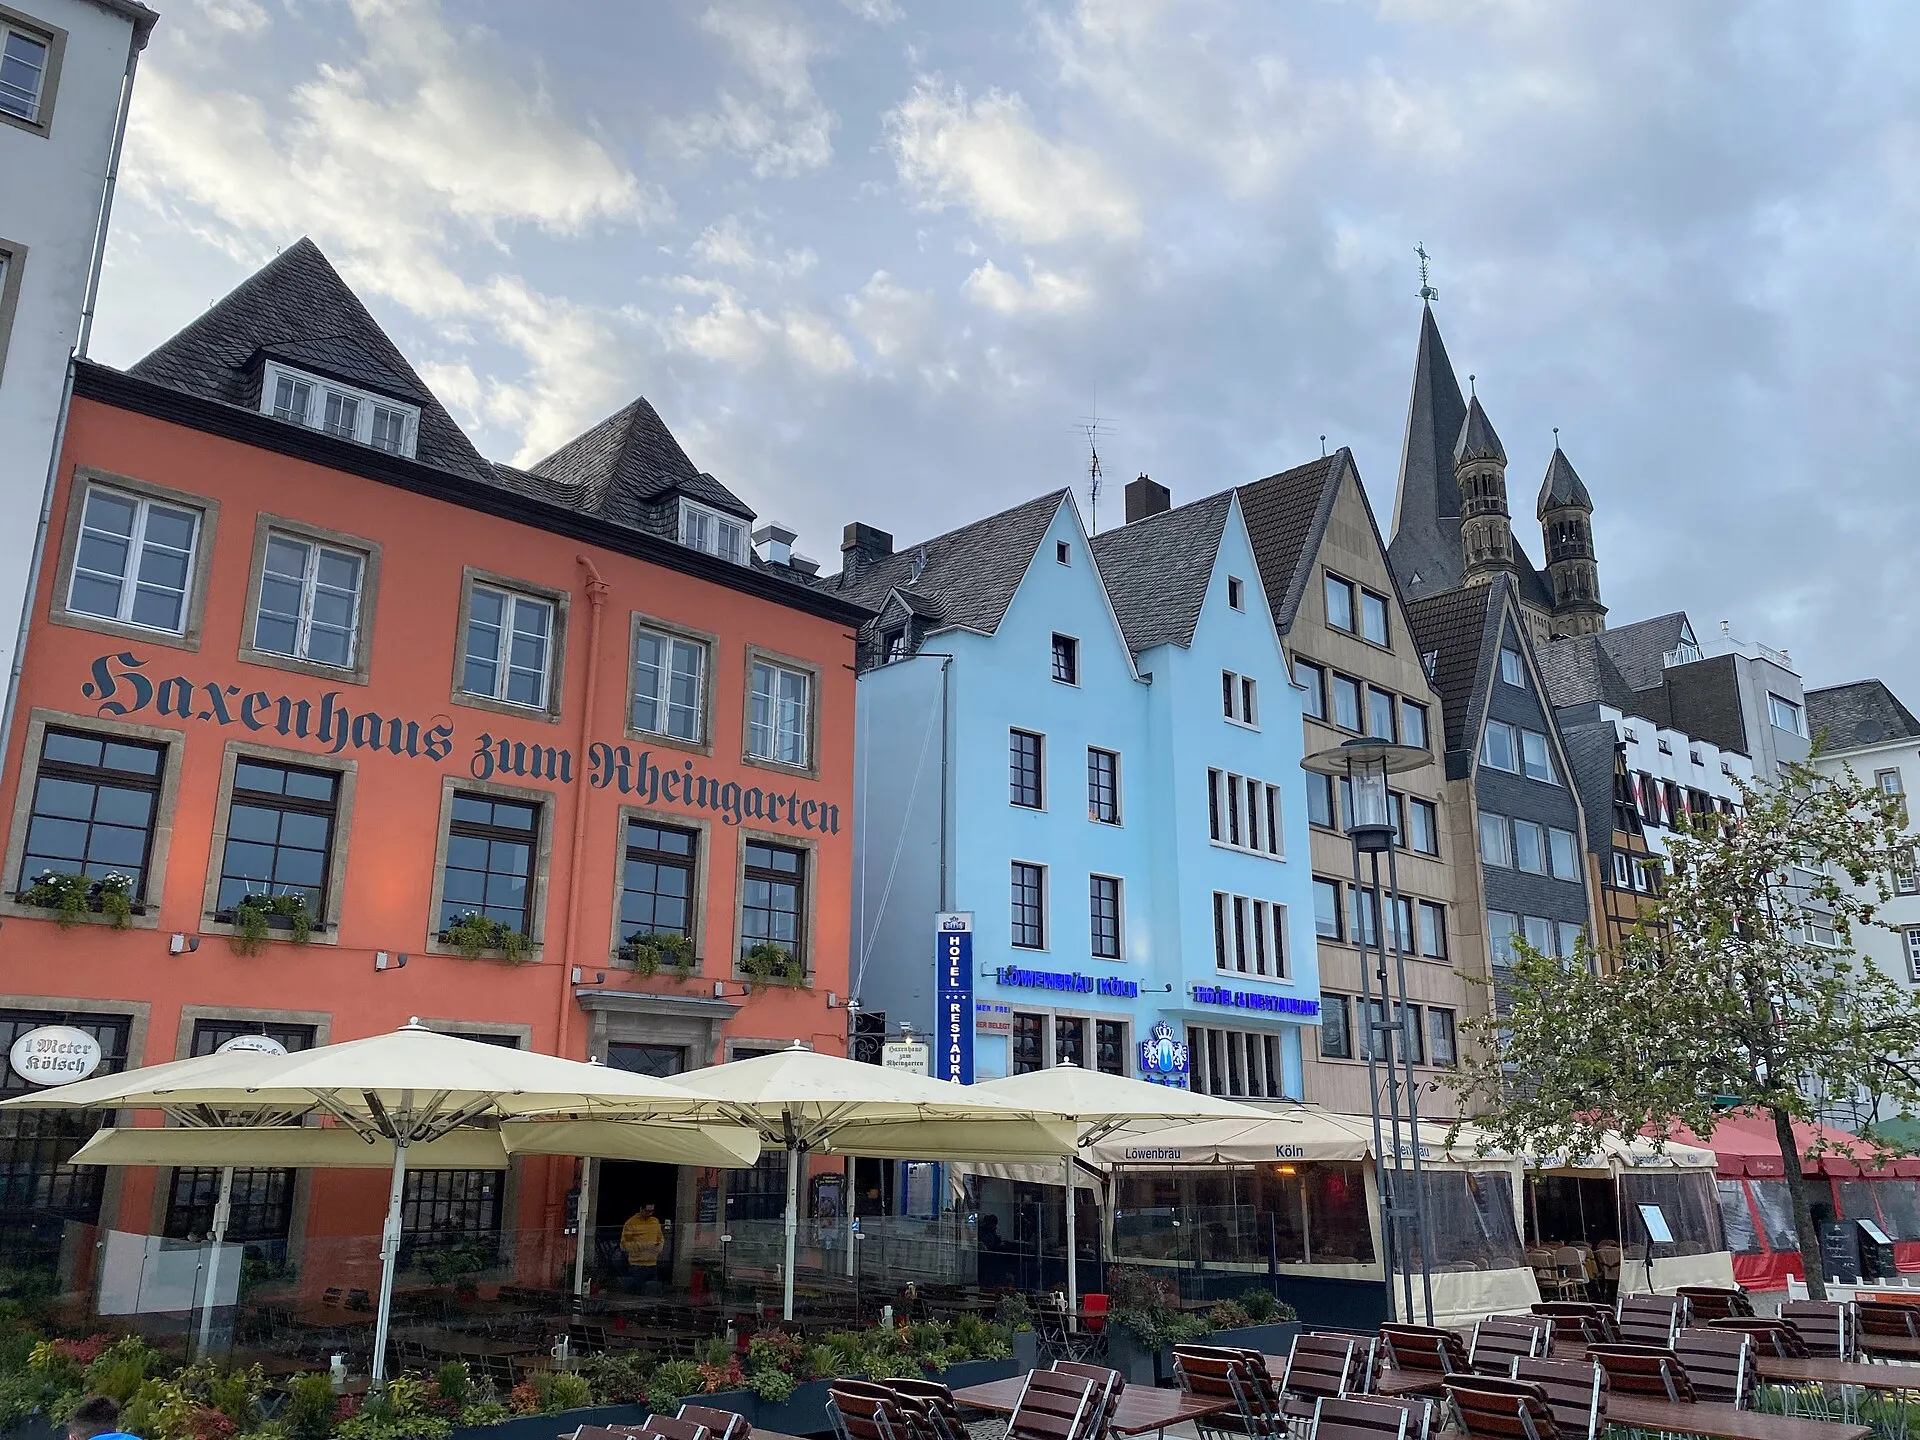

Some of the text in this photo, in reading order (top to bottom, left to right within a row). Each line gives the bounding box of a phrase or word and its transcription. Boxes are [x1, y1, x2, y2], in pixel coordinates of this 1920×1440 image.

[80, 651, 842, 836] Haxenhaus zum Rheingarten
[949, 936, 960, 987] HOTEL
[997, 965, 1138, 998] LÖWENBRÄU KÖLN
[995, 1005, 1010, 1014] FREI
[1247, 993, 1319, 1016] RESTAURANT
[987, 1022, 1010, 1030] BELEGT
[24, 1038, 92, 1055] 1 Meter
[25, 1055, 85, 1075] Kölsch
[886, 1060, 924, 1068] Rheingarten
[1125, 1144, 1304, 1159] Löwenbräu Köln
